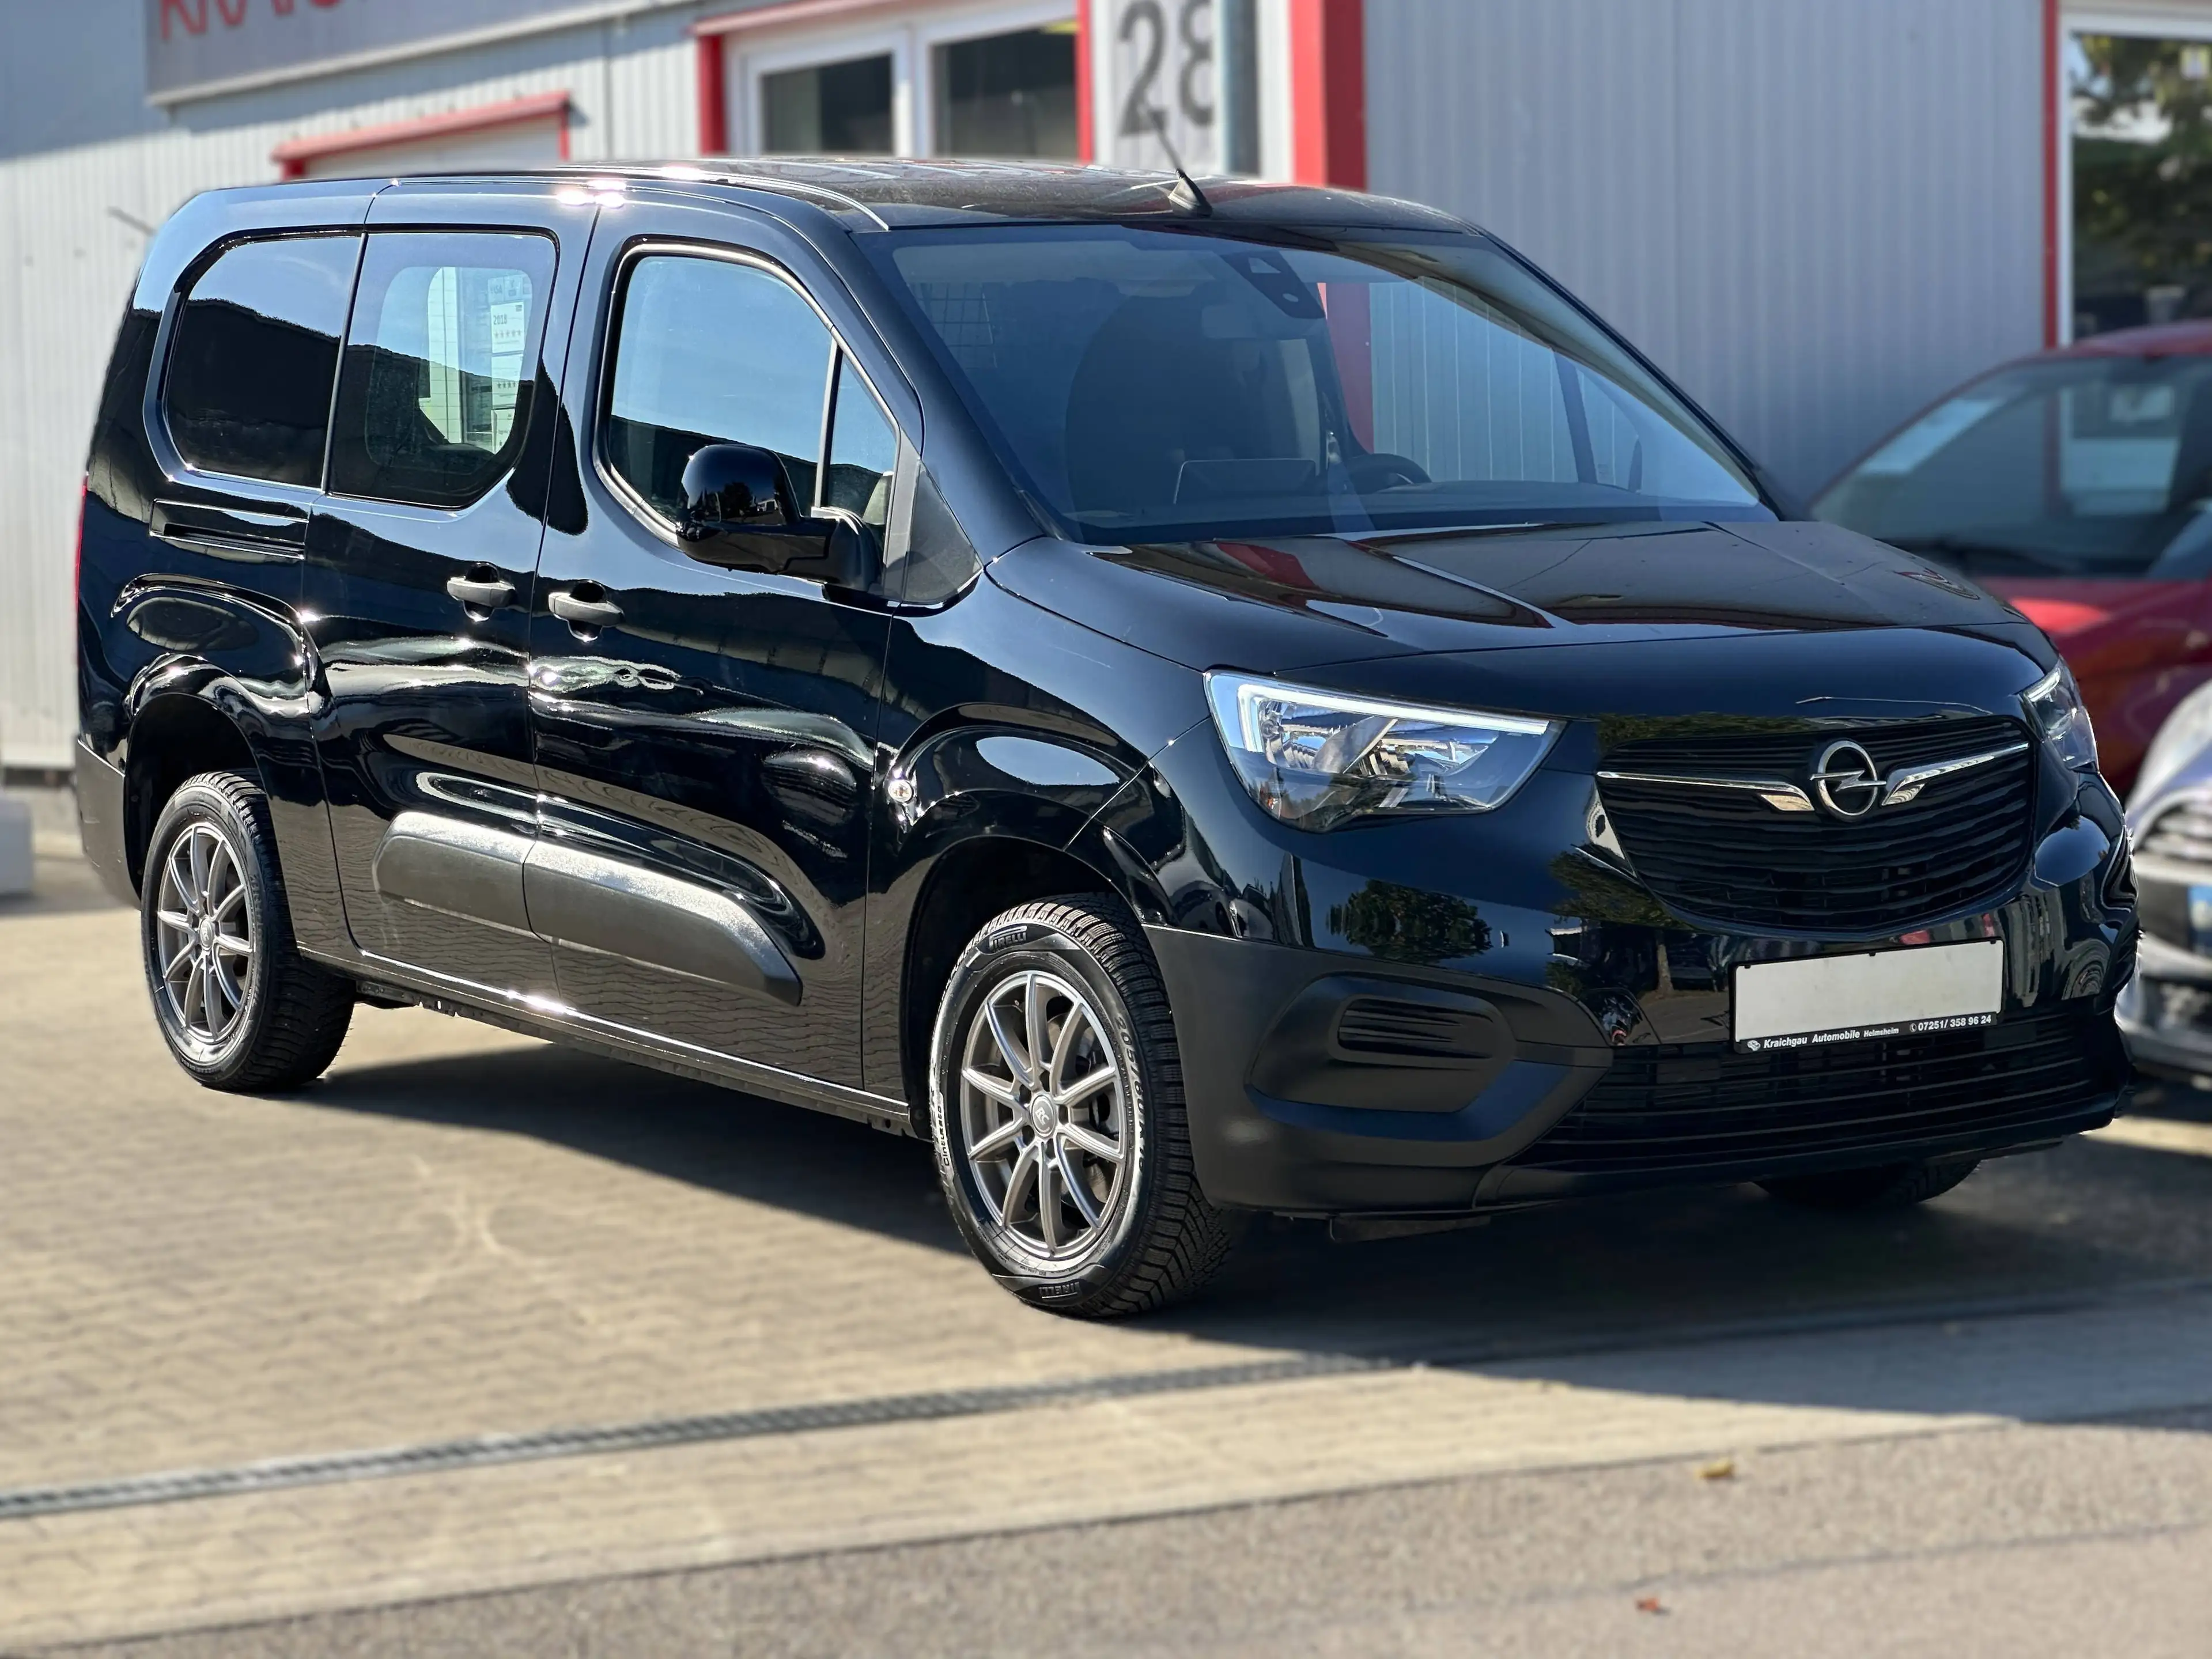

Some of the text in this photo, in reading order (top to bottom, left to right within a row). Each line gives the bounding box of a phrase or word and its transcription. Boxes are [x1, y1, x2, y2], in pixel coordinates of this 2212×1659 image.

[989, 926, 1027, 950] PIRELLI
[1763, 1036, 1808, 1049] Kraichgau
[1812, 1030, 1860, 1043] Automobile
[1918, 1019, 1948, 1031] 07251/
[1950, 1017, 1966, 1028] 358
[1968, 1016, 1979, 1025] 96
[1980, 1014, 1991, 1024] 24
